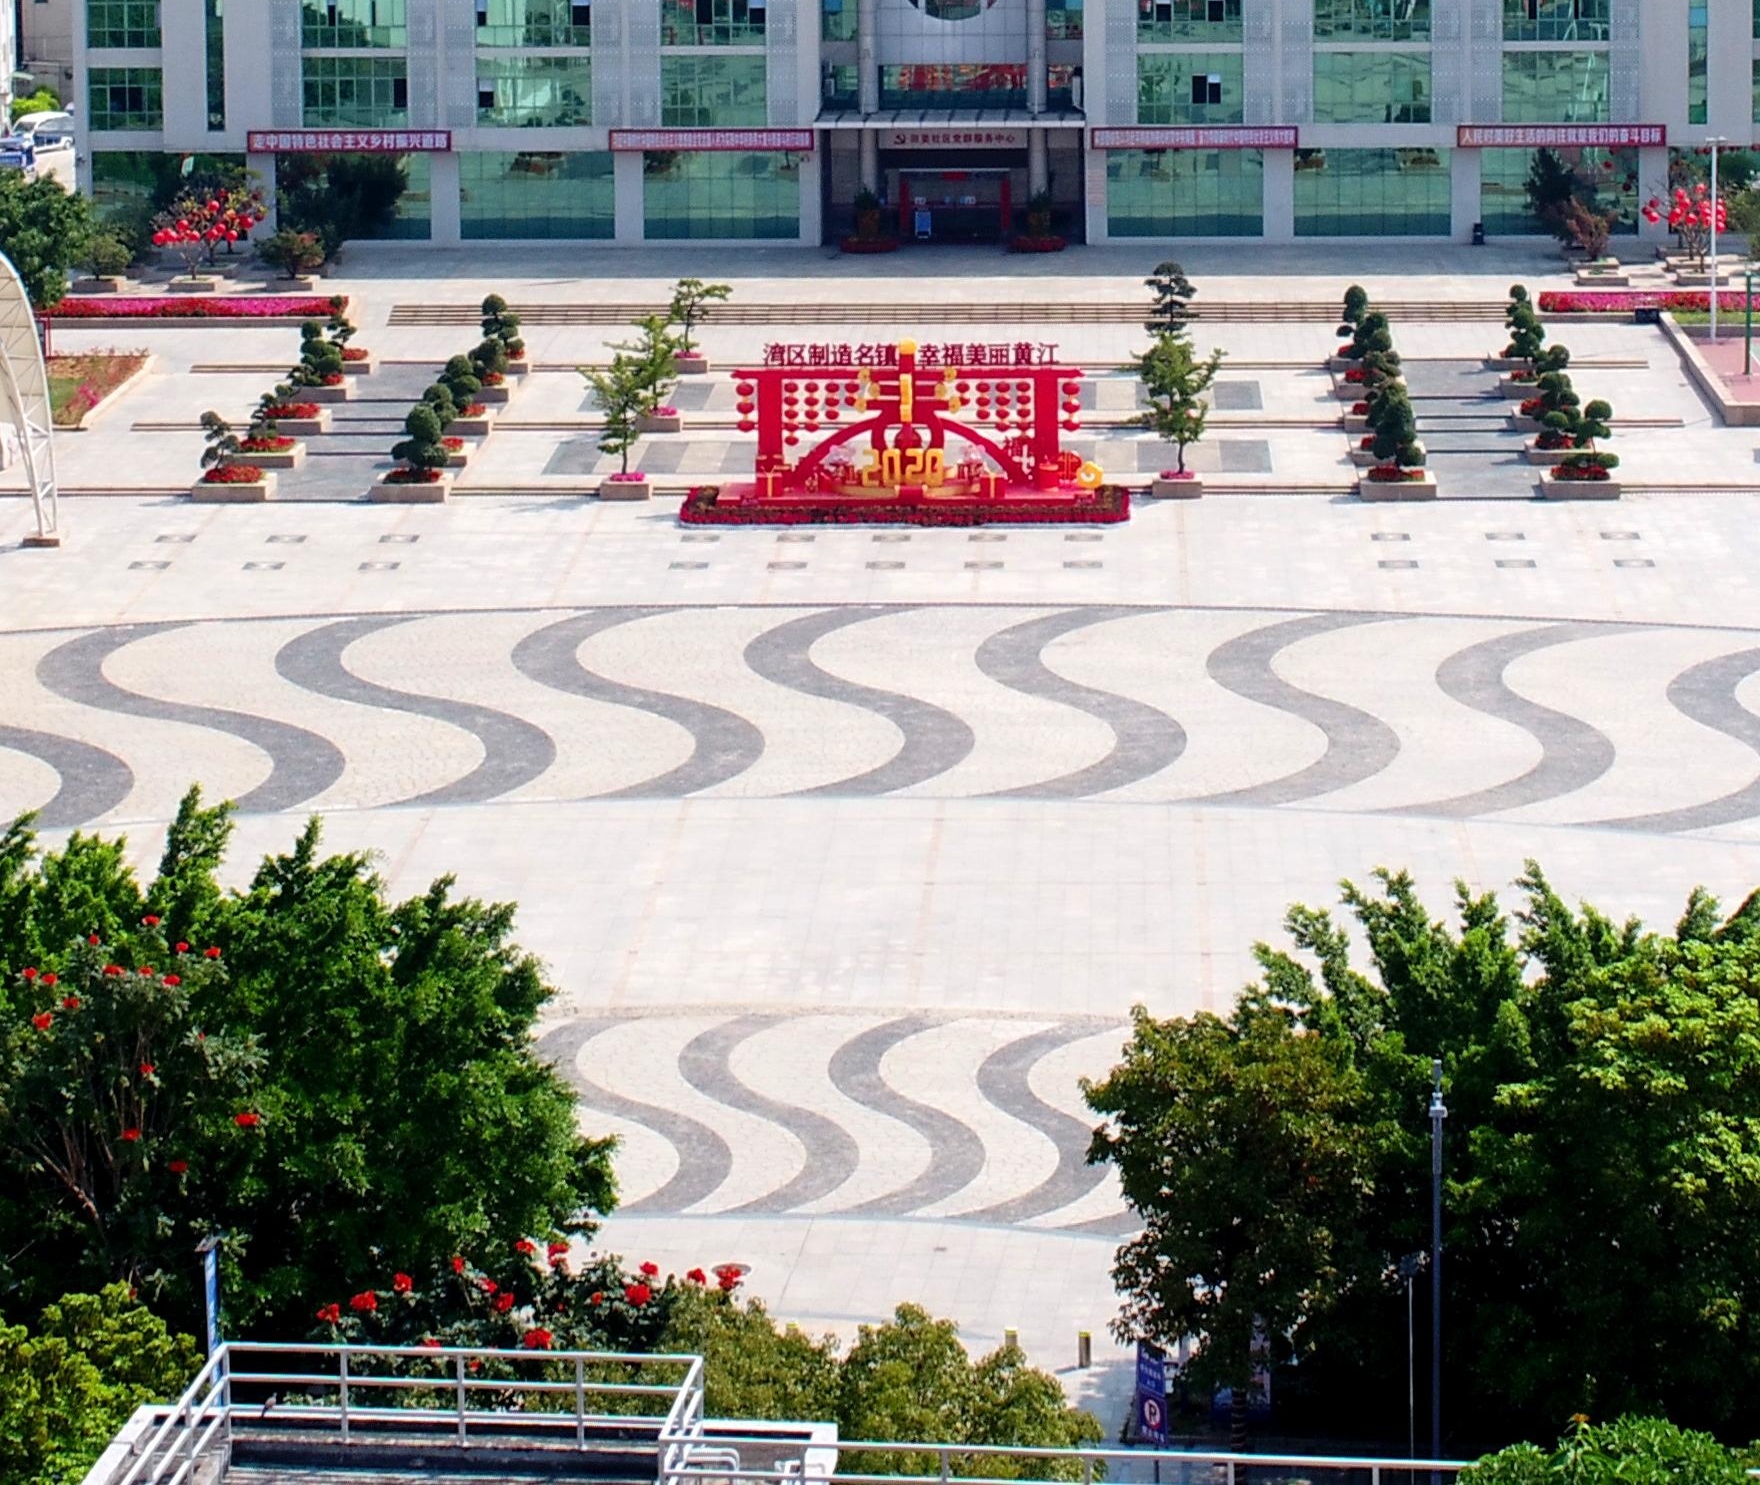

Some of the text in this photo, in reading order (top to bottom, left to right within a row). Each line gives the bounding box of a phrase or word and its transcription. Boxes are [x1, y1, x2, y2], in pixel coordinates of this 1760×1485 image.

[253, 133, 448, 149] 走中国特色社会主义乡村振兴道路
[762, 343, 1059, 365] 湾区制造名镇 幸福美丽黄江
[862, 447, 944, 487] 2020
